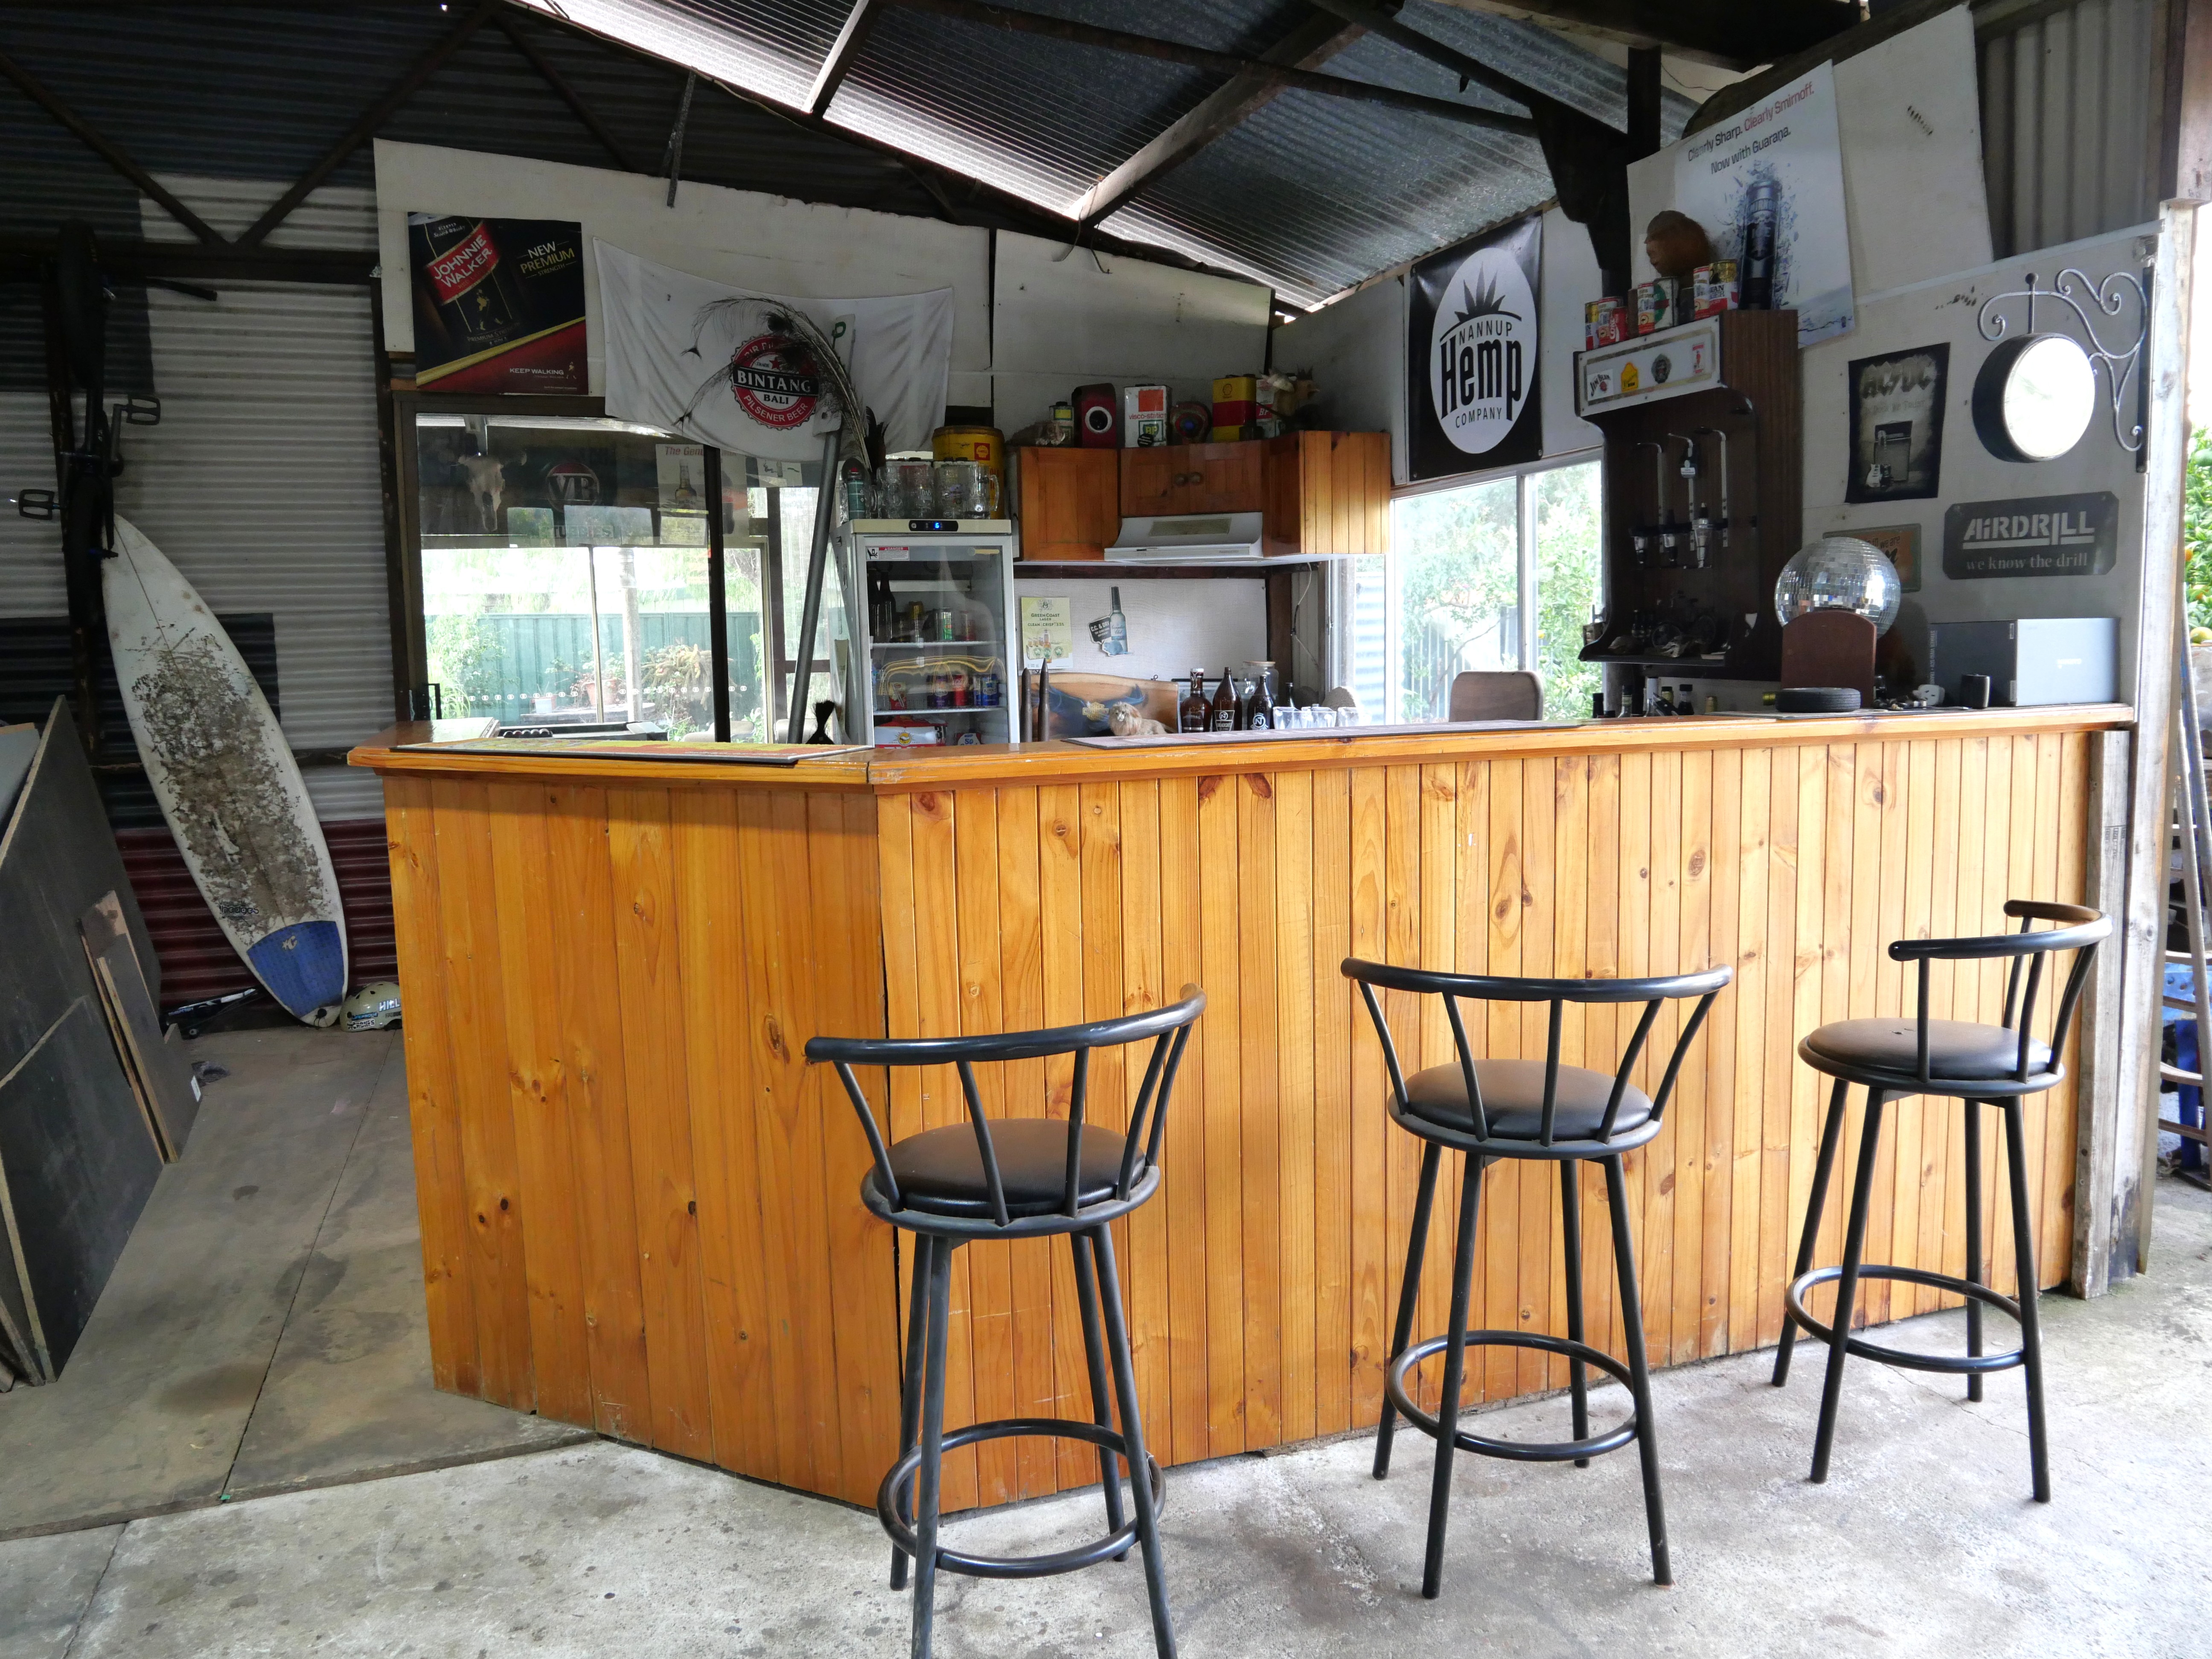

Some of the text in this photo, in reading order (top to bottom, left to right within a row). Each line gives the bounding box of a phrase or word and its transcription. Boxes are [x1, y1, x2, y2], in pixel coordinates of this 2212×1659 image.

[1688, 81, 1814, 161] Clearly Sharp. Clearly Smirnoff.
[1711, 127, 1791, 174] Now with Guarana.
[434, 234, 486, 279] JOHNNIE
[520, 248, 575, 274] PREMIUM
[528, 241, 556, 259] NEW
[441, 248, 492, 288] WALKER
[538, 263, 565, 276] STRENGTH
[1459, 321, 1512, 345] NANNUP
[737, 370, 810, 393] BINTANG
[1441, 334, 1522, 421] Hemp
[744, 395, 808, 422] PILSENER BEER
[764, 394, 789, 405] BALI
[1455, 407, 1502, 428] COMPANY
[1145, 426, 1158, 434] BP
[666, 446, 681, 455] The
[547, 475, 596, 501] VB
[1967, 552, 2087, 570] we know the drill
[1254, 717, 1264, 725] NT
[219, 904, 259, 915] hedges
